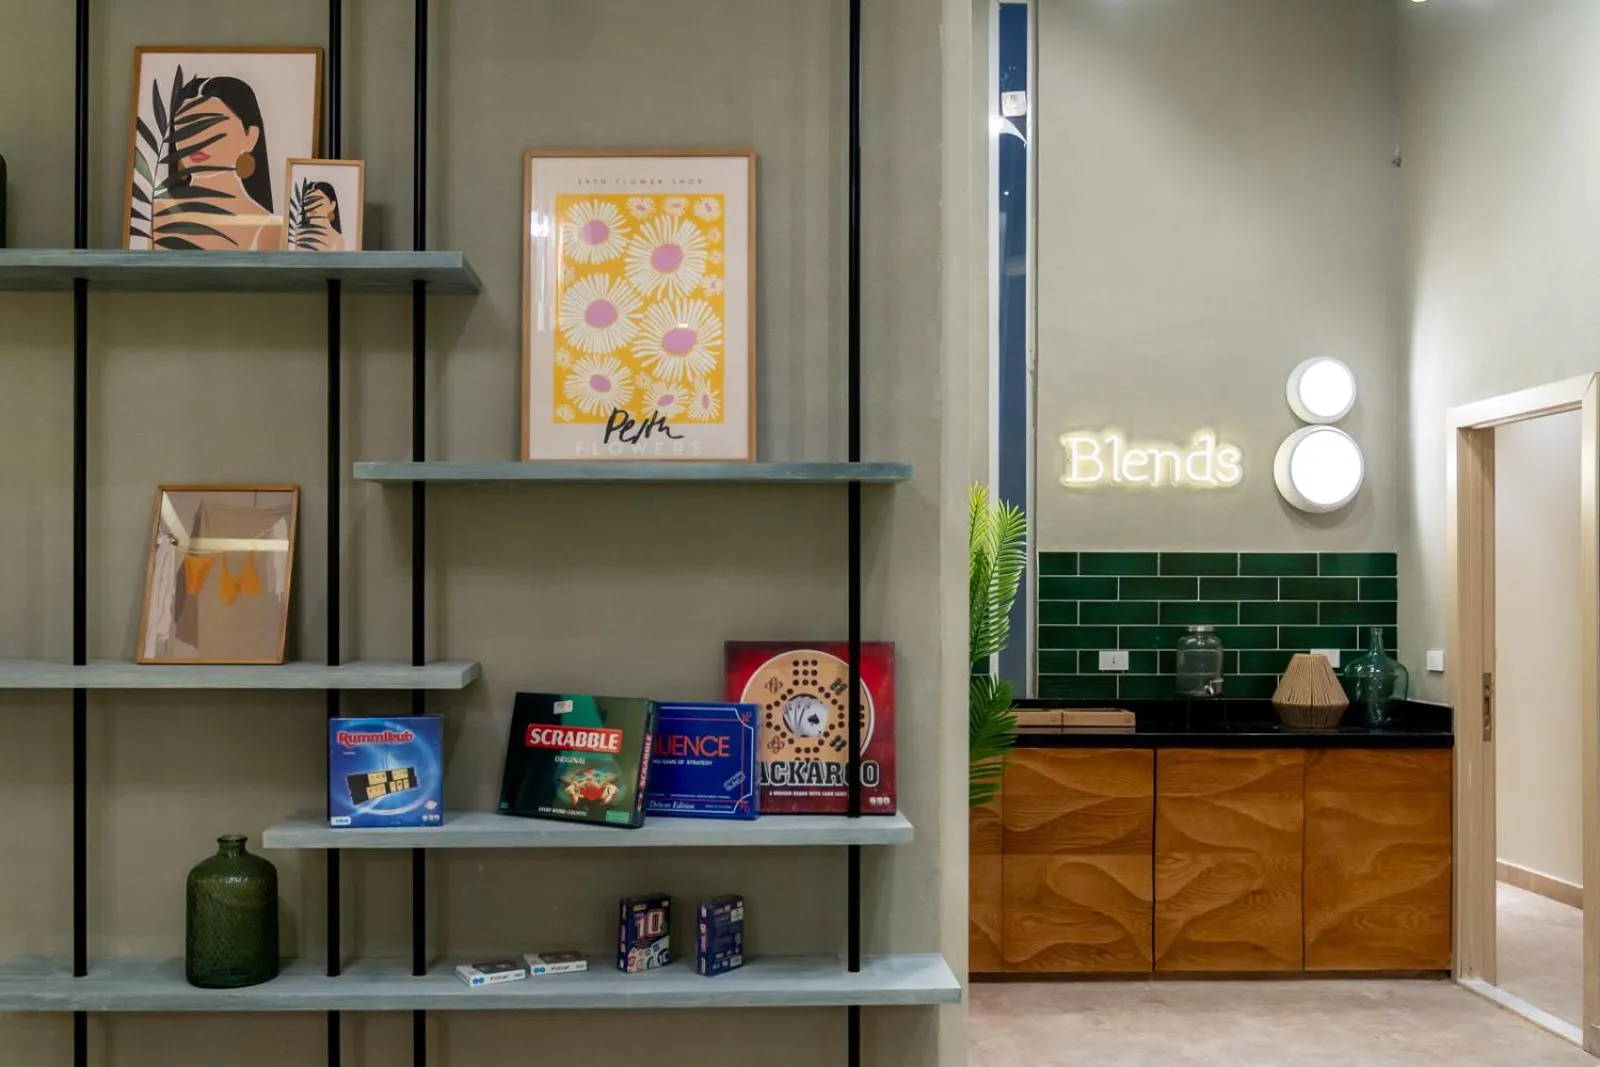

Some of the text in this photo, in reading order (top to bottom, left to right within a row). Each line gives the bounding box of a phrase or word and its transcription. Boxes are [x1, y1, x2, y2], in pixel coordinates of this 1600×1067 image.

[603, 407, 684, 444] Perth
[575, 441, 701, 456] FLOWERS
[1060, 432, 1242, 487] Blends
[337, 730, 414, 748] Rummikub
[530, 728, 619, 750] SCRABBLE
[655, 735, 731, 757] UENCE
[759, 761, 880, 787] ACKARO
